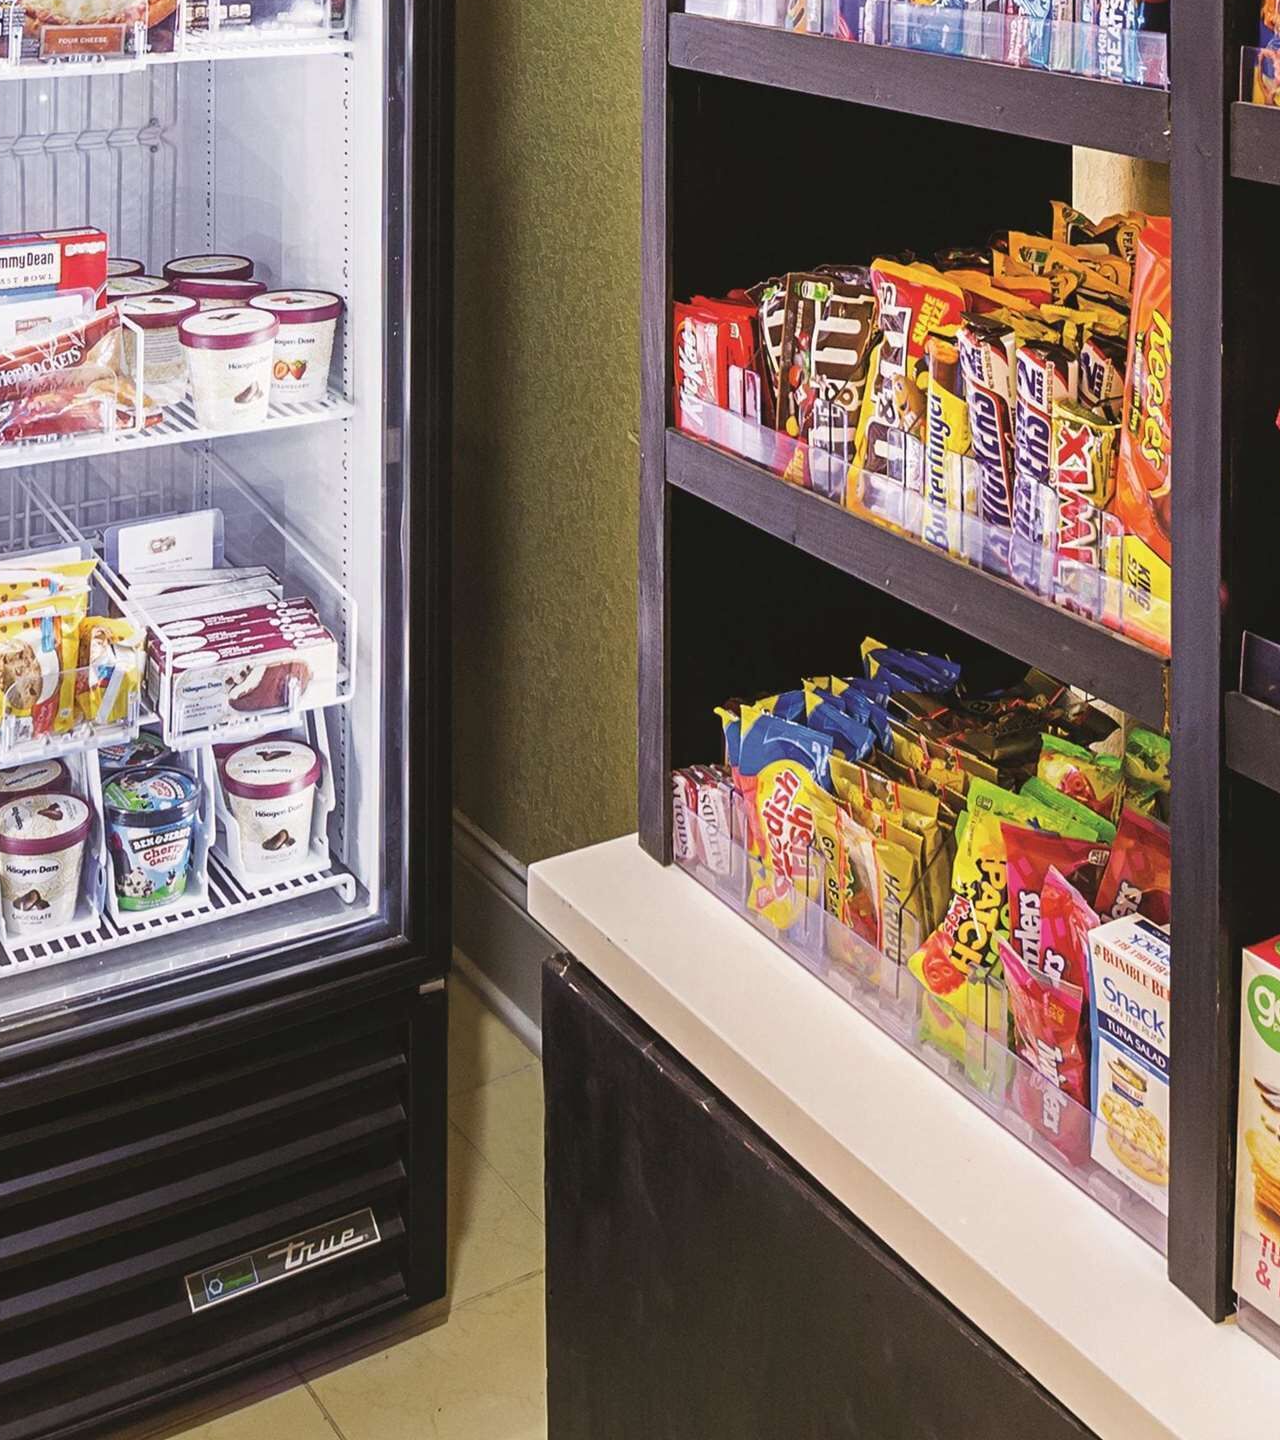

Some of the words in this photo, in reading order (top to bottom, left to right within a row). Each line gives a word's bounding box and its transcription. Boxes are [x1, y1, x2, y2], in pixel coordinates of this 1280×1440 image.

[25, 250, 54, 267] Dean
[911, 292, 935, 348] SHARE
[926, 298, 949, 337] SIZE
[1057, 423, 1094, 577] TWIX
[1139, 559, 1152, 612] KING
[760, 768, 802, 902] Swedish
[786, 804, 818, 884] Fish
[950, 857, 1008, 976] PATCH
[1102, 946, 1148, 991] BUMBLE
[1102, 976, 1168, 1040] Snack
[1106, 1017, 1135, 1045] TUNA
[1134, 1038, 1168, 1069] SALAD
[1254, 1259, 1273, 1291] &
